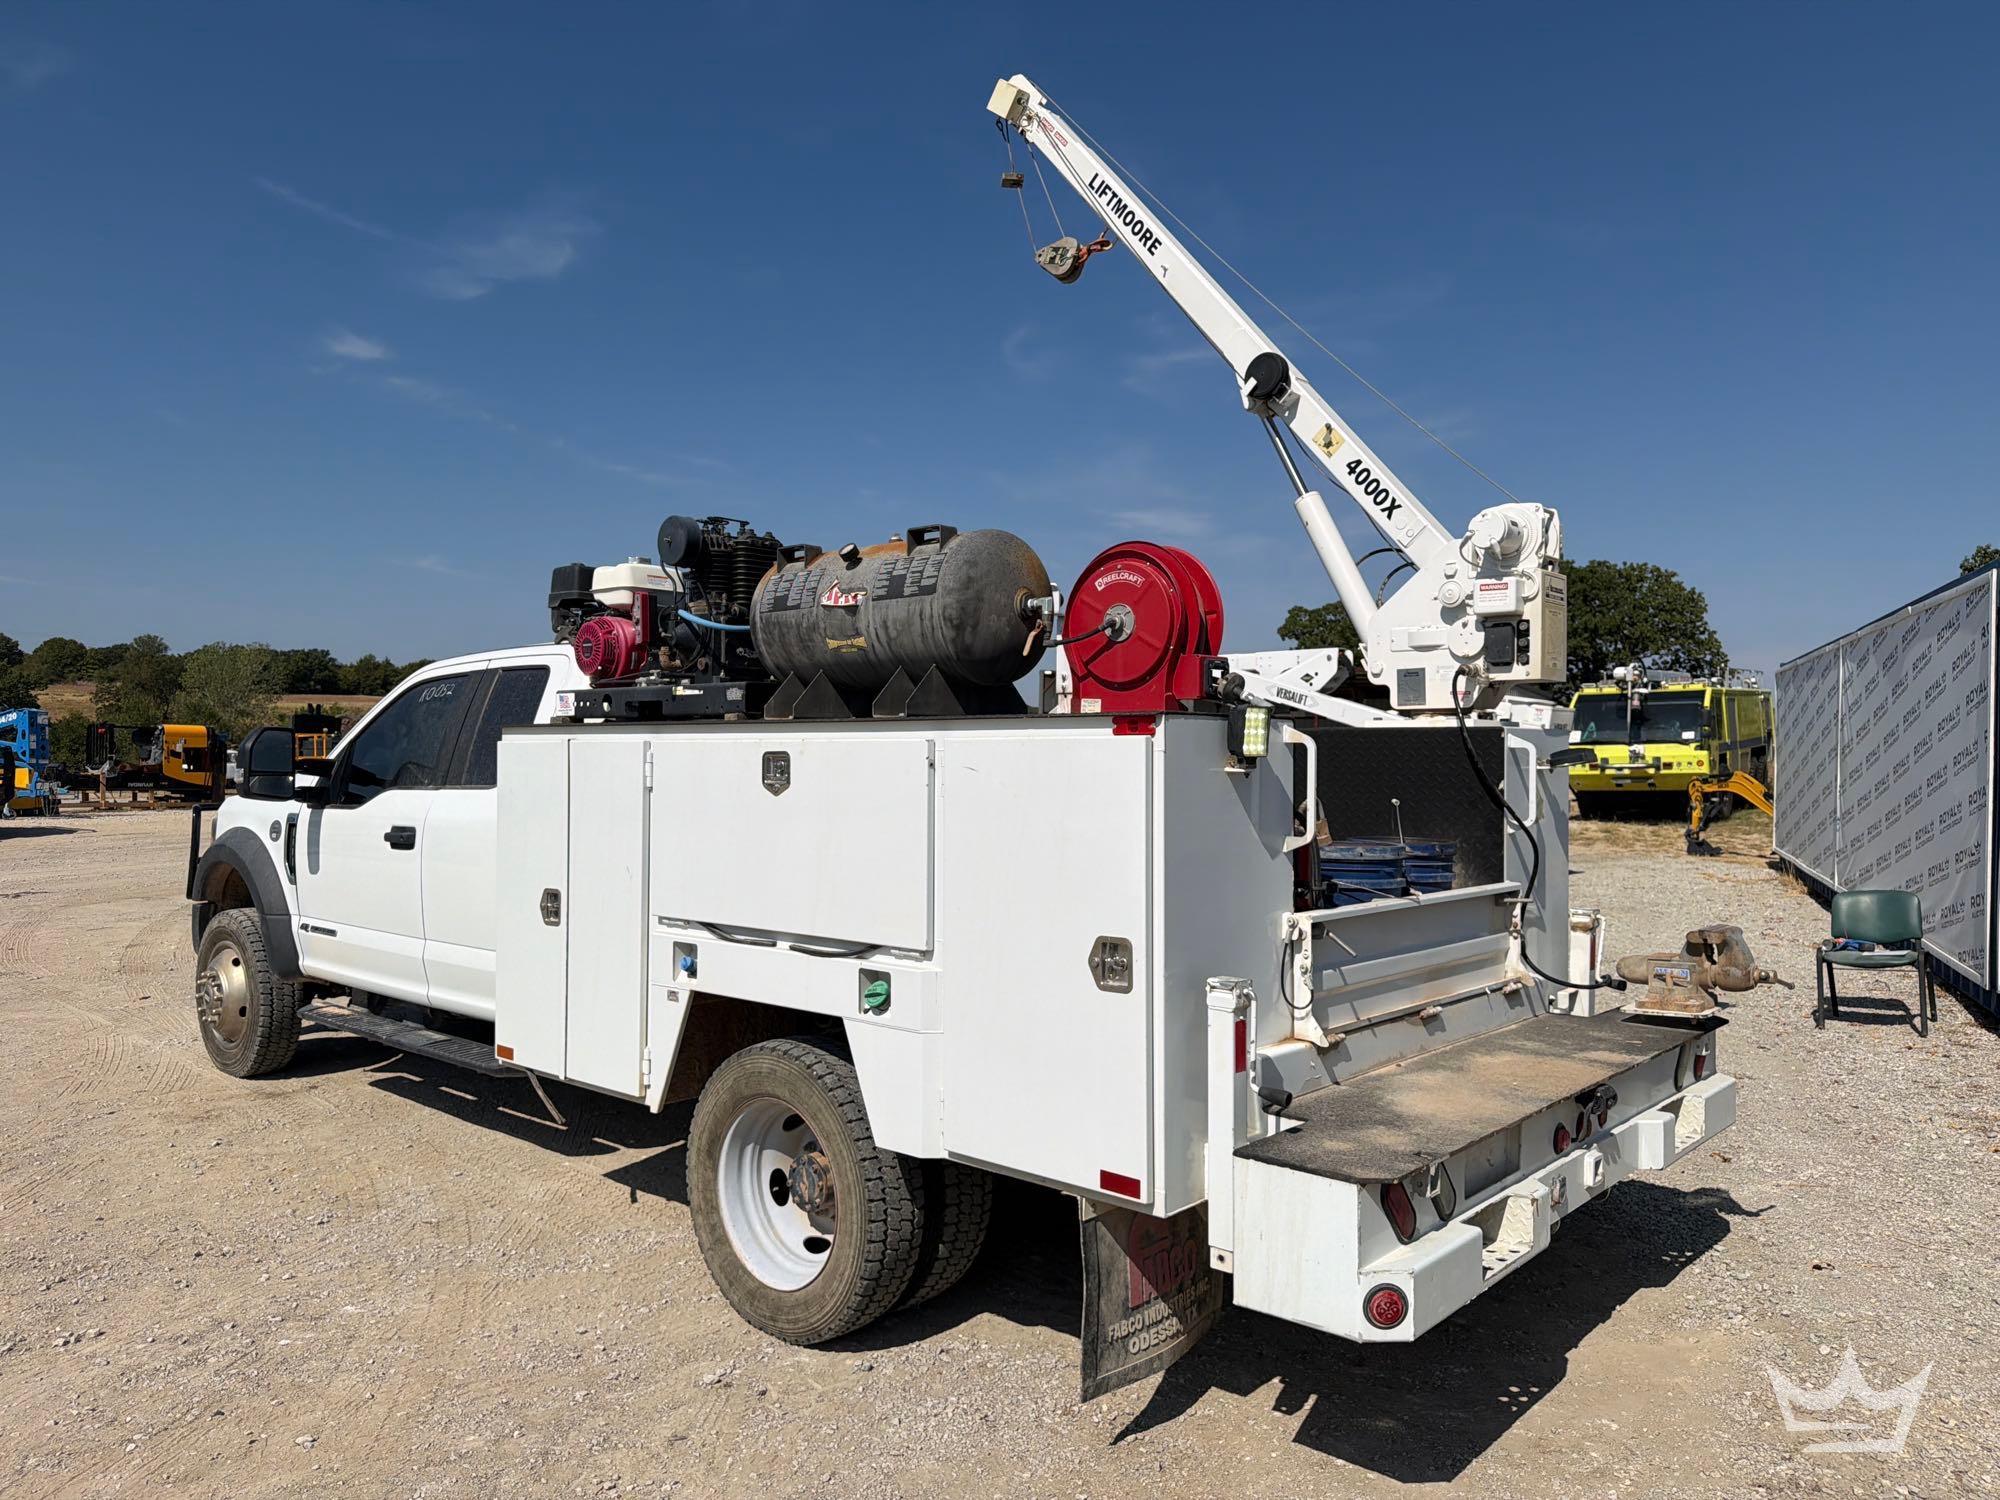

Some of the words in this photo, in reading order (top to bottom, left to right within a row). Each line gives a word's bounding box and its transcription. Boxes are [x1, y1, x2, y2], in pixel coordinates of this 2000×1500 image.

[1088, 172, 1162, 257] LIFTMOORE
[1345, 458, 1402, 521] 4000X
[1103, 572, 1142, 585] REELCRAFT
[1937, 618, 1955, 644] ROYAL
[1952, 646, 1970, 673] ROYAL
[1276, 686, 1308, 706] VERSALIFT
[1925, 680, 1942, 701] ROYAL
[1966, 682, 1988, 707] ROYAL
[1938, 712, 1956, 734] ROYAL
[1914, 738, 1928, 757] ROYAL
[1953, 746, 1972, 768] ROYAL
[1926, 770, 1943, 789] ROYAL
[1939, 806, 1958, 826] ROYAL
[1915, 826, 1930, 842] ROYAL
[1955, 848, 1976, 866] ROYAL
[1928, 863, 1946, 880] ROYAL
[1940, 904, 1960, 920] ROYAL
[1108, 1314, 1143, 1343] FABCO
